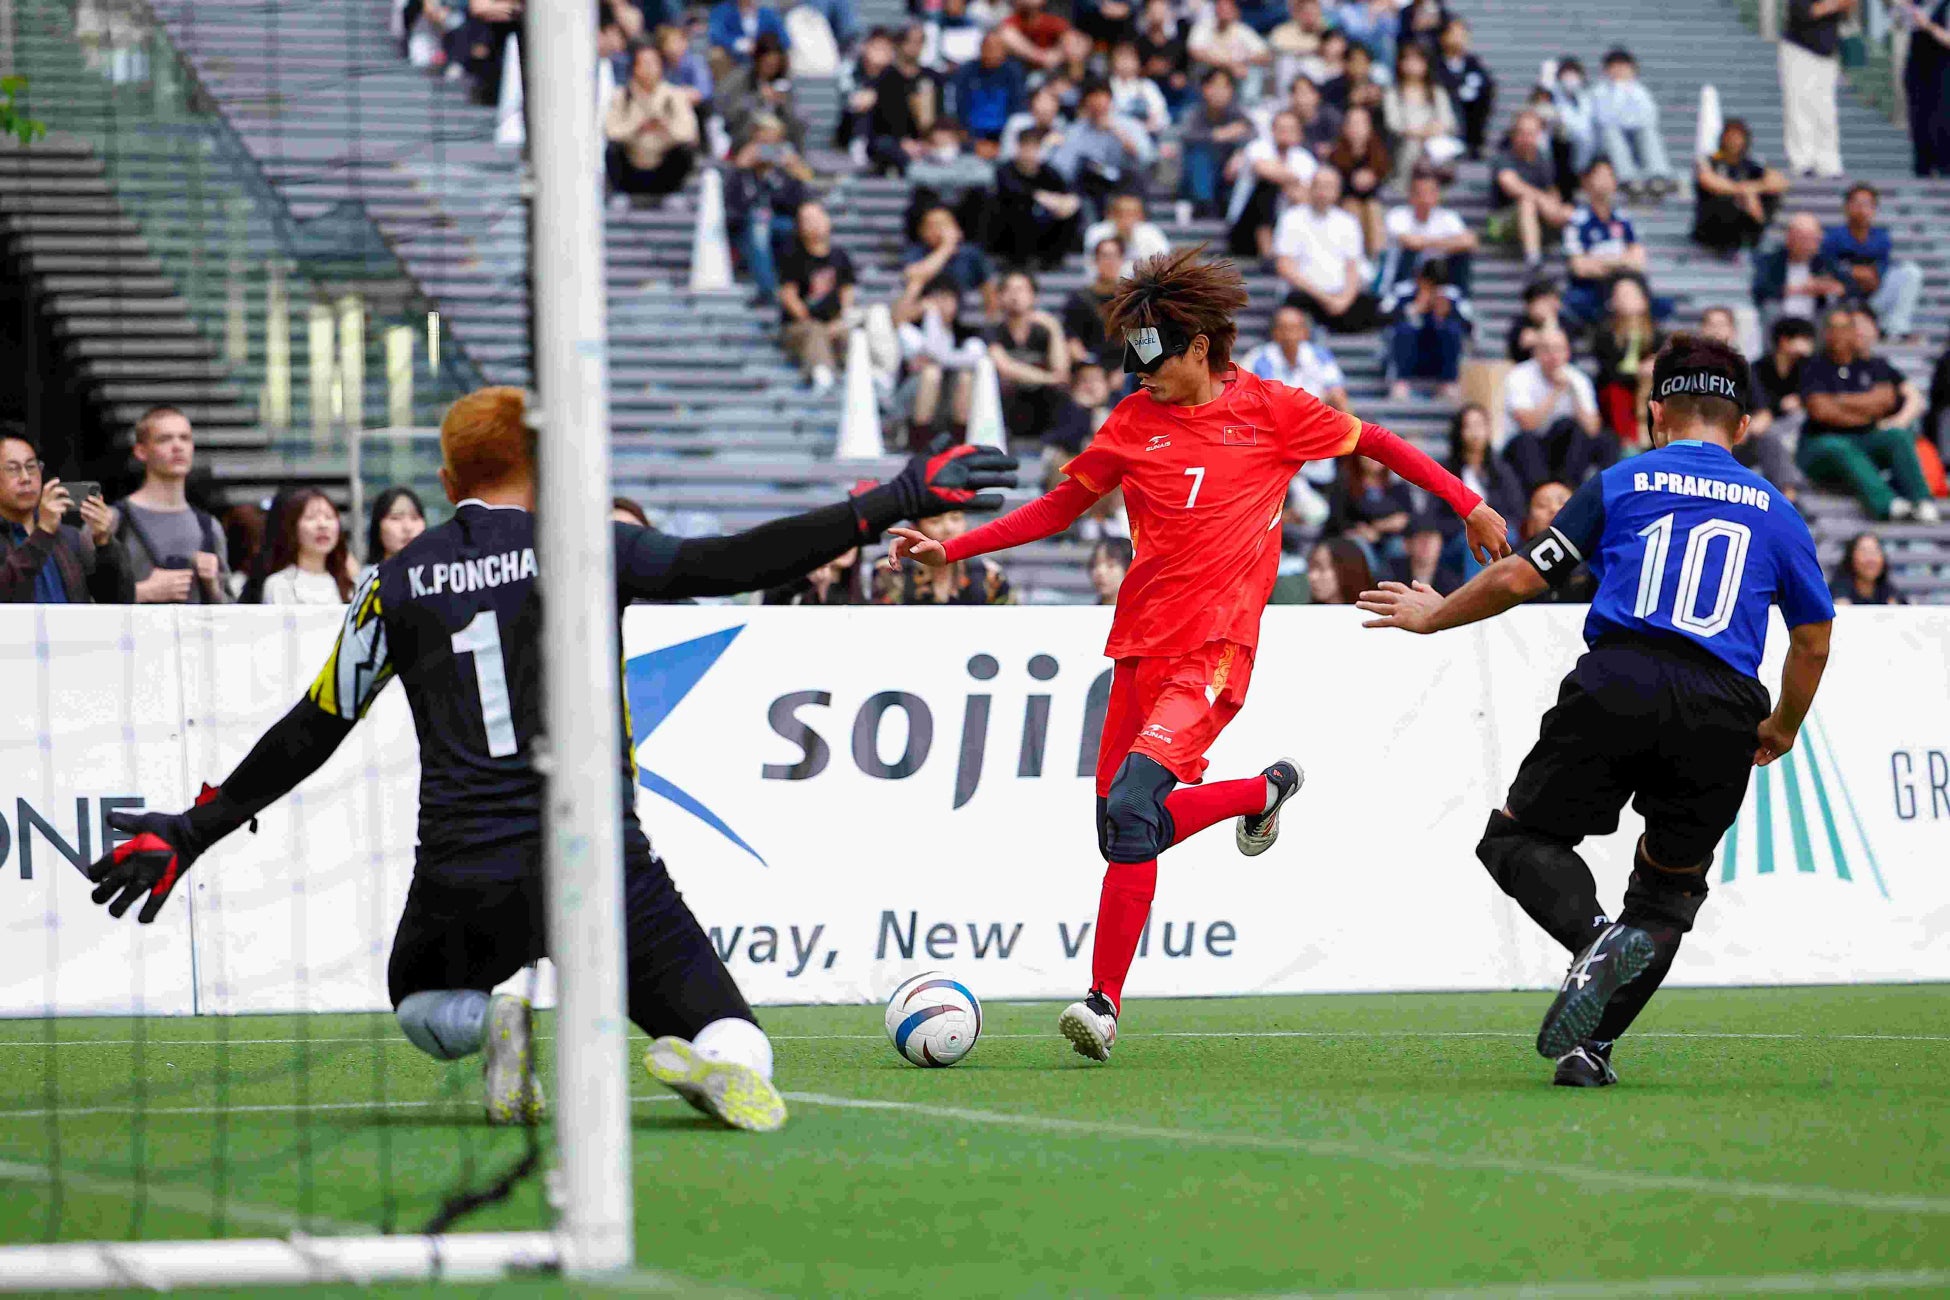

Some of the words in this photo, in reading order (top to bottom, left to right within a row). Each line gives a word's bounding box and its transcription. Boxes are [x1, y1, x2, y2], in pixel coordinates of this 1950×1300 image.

[1184, 467, 1205, 509] 7
[1633, 472, 1771, 512] B.PRAKRONG
[1530, 537, 1565, 572] C
[1633, 512, 1752, 638] 10
[451, 610, 519, 759] 1
[0, 797, 145, 880] NE
[875, 910, 1024, 960] New
[1058, 905, 1237, 959] vlue
